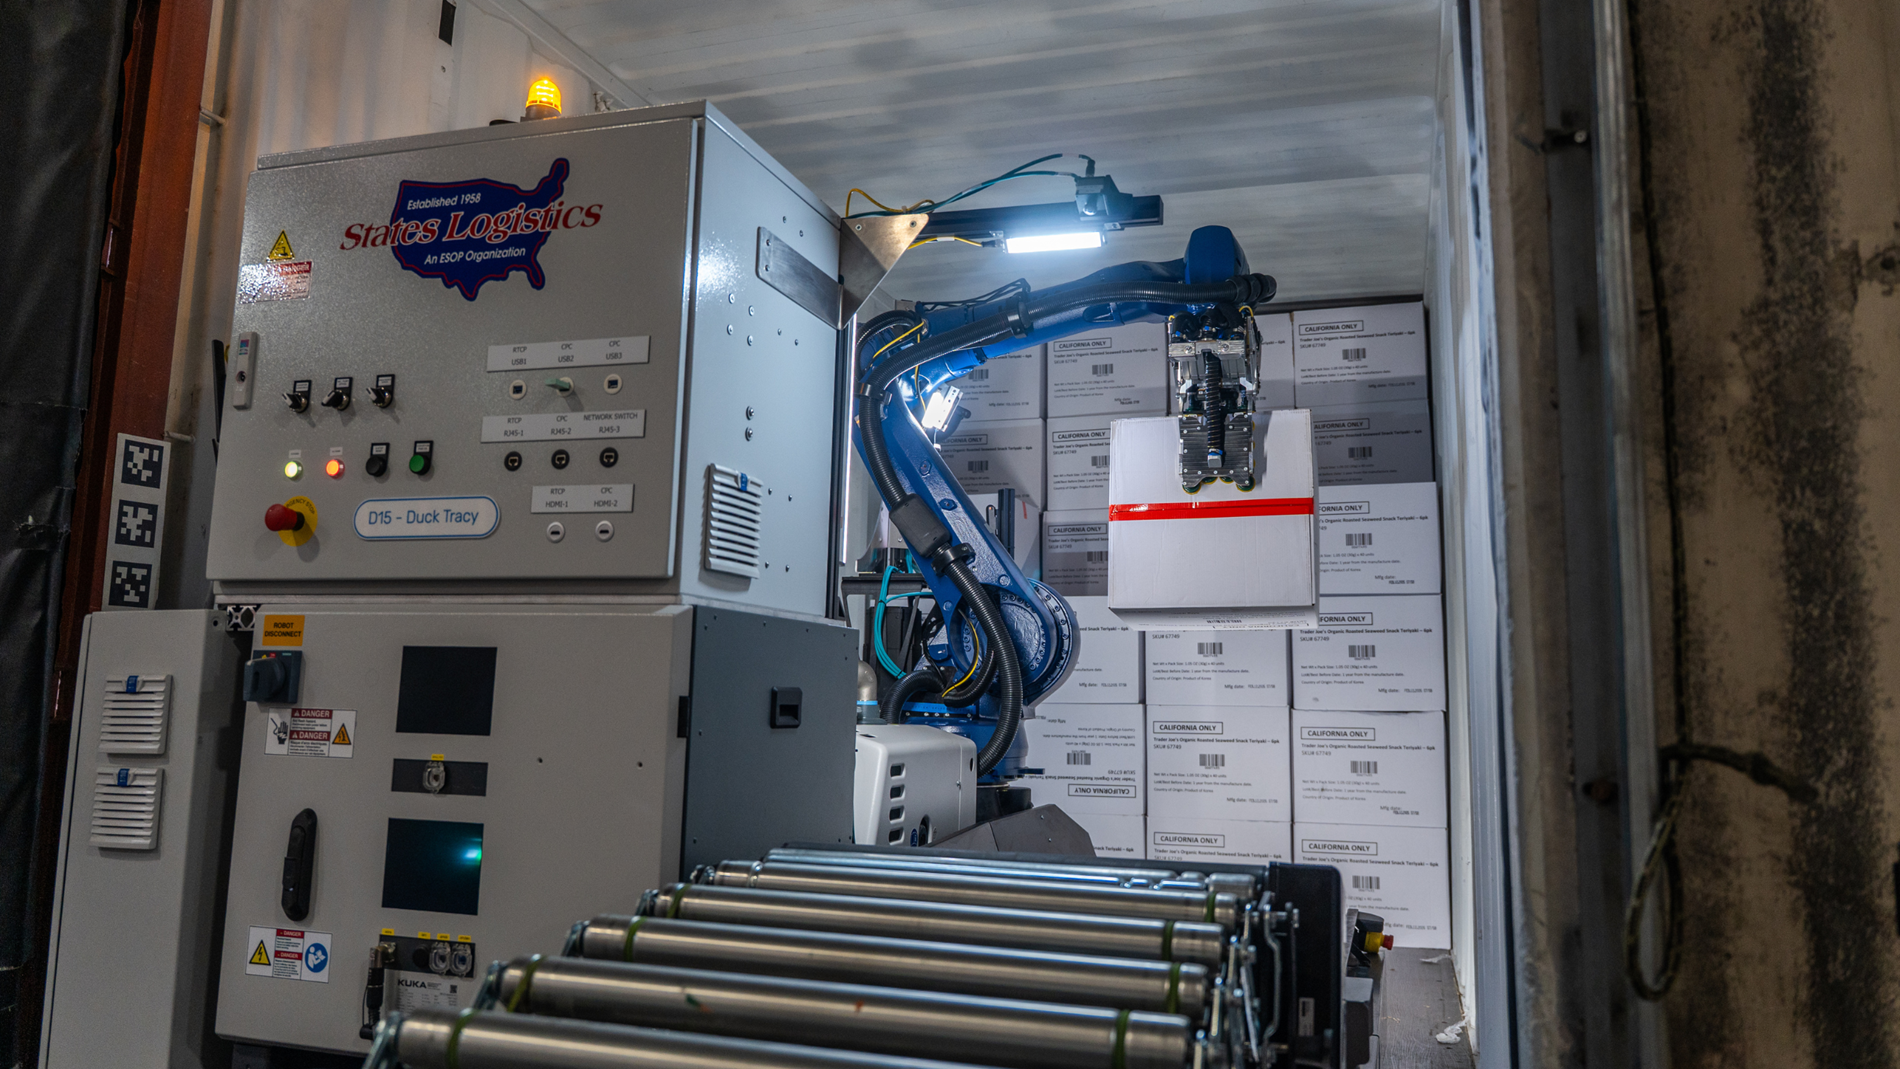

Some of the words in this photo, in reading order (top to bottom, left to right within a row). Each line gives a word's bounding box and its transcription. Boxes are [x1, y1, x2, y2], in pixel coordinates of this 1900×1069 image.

[407, 196, 457, 210] Established
[460, 193, 481, 204] 1958
[340, 218, 441, 250] States
[442, 201, 604, 243] Logistics
[424, 254, 438, 265] An
[440, 252, 464, 264] ESOP
[466, 247, 526, 262] Organization
[368, 511, 392, 525] D15
[406, 510, 439, 524] Duck
[443, 509, 479, 525] Tracy
[1309, 843, 1350, 851] CALIFORNIA
[398, 979, 426, 989] KUKA
